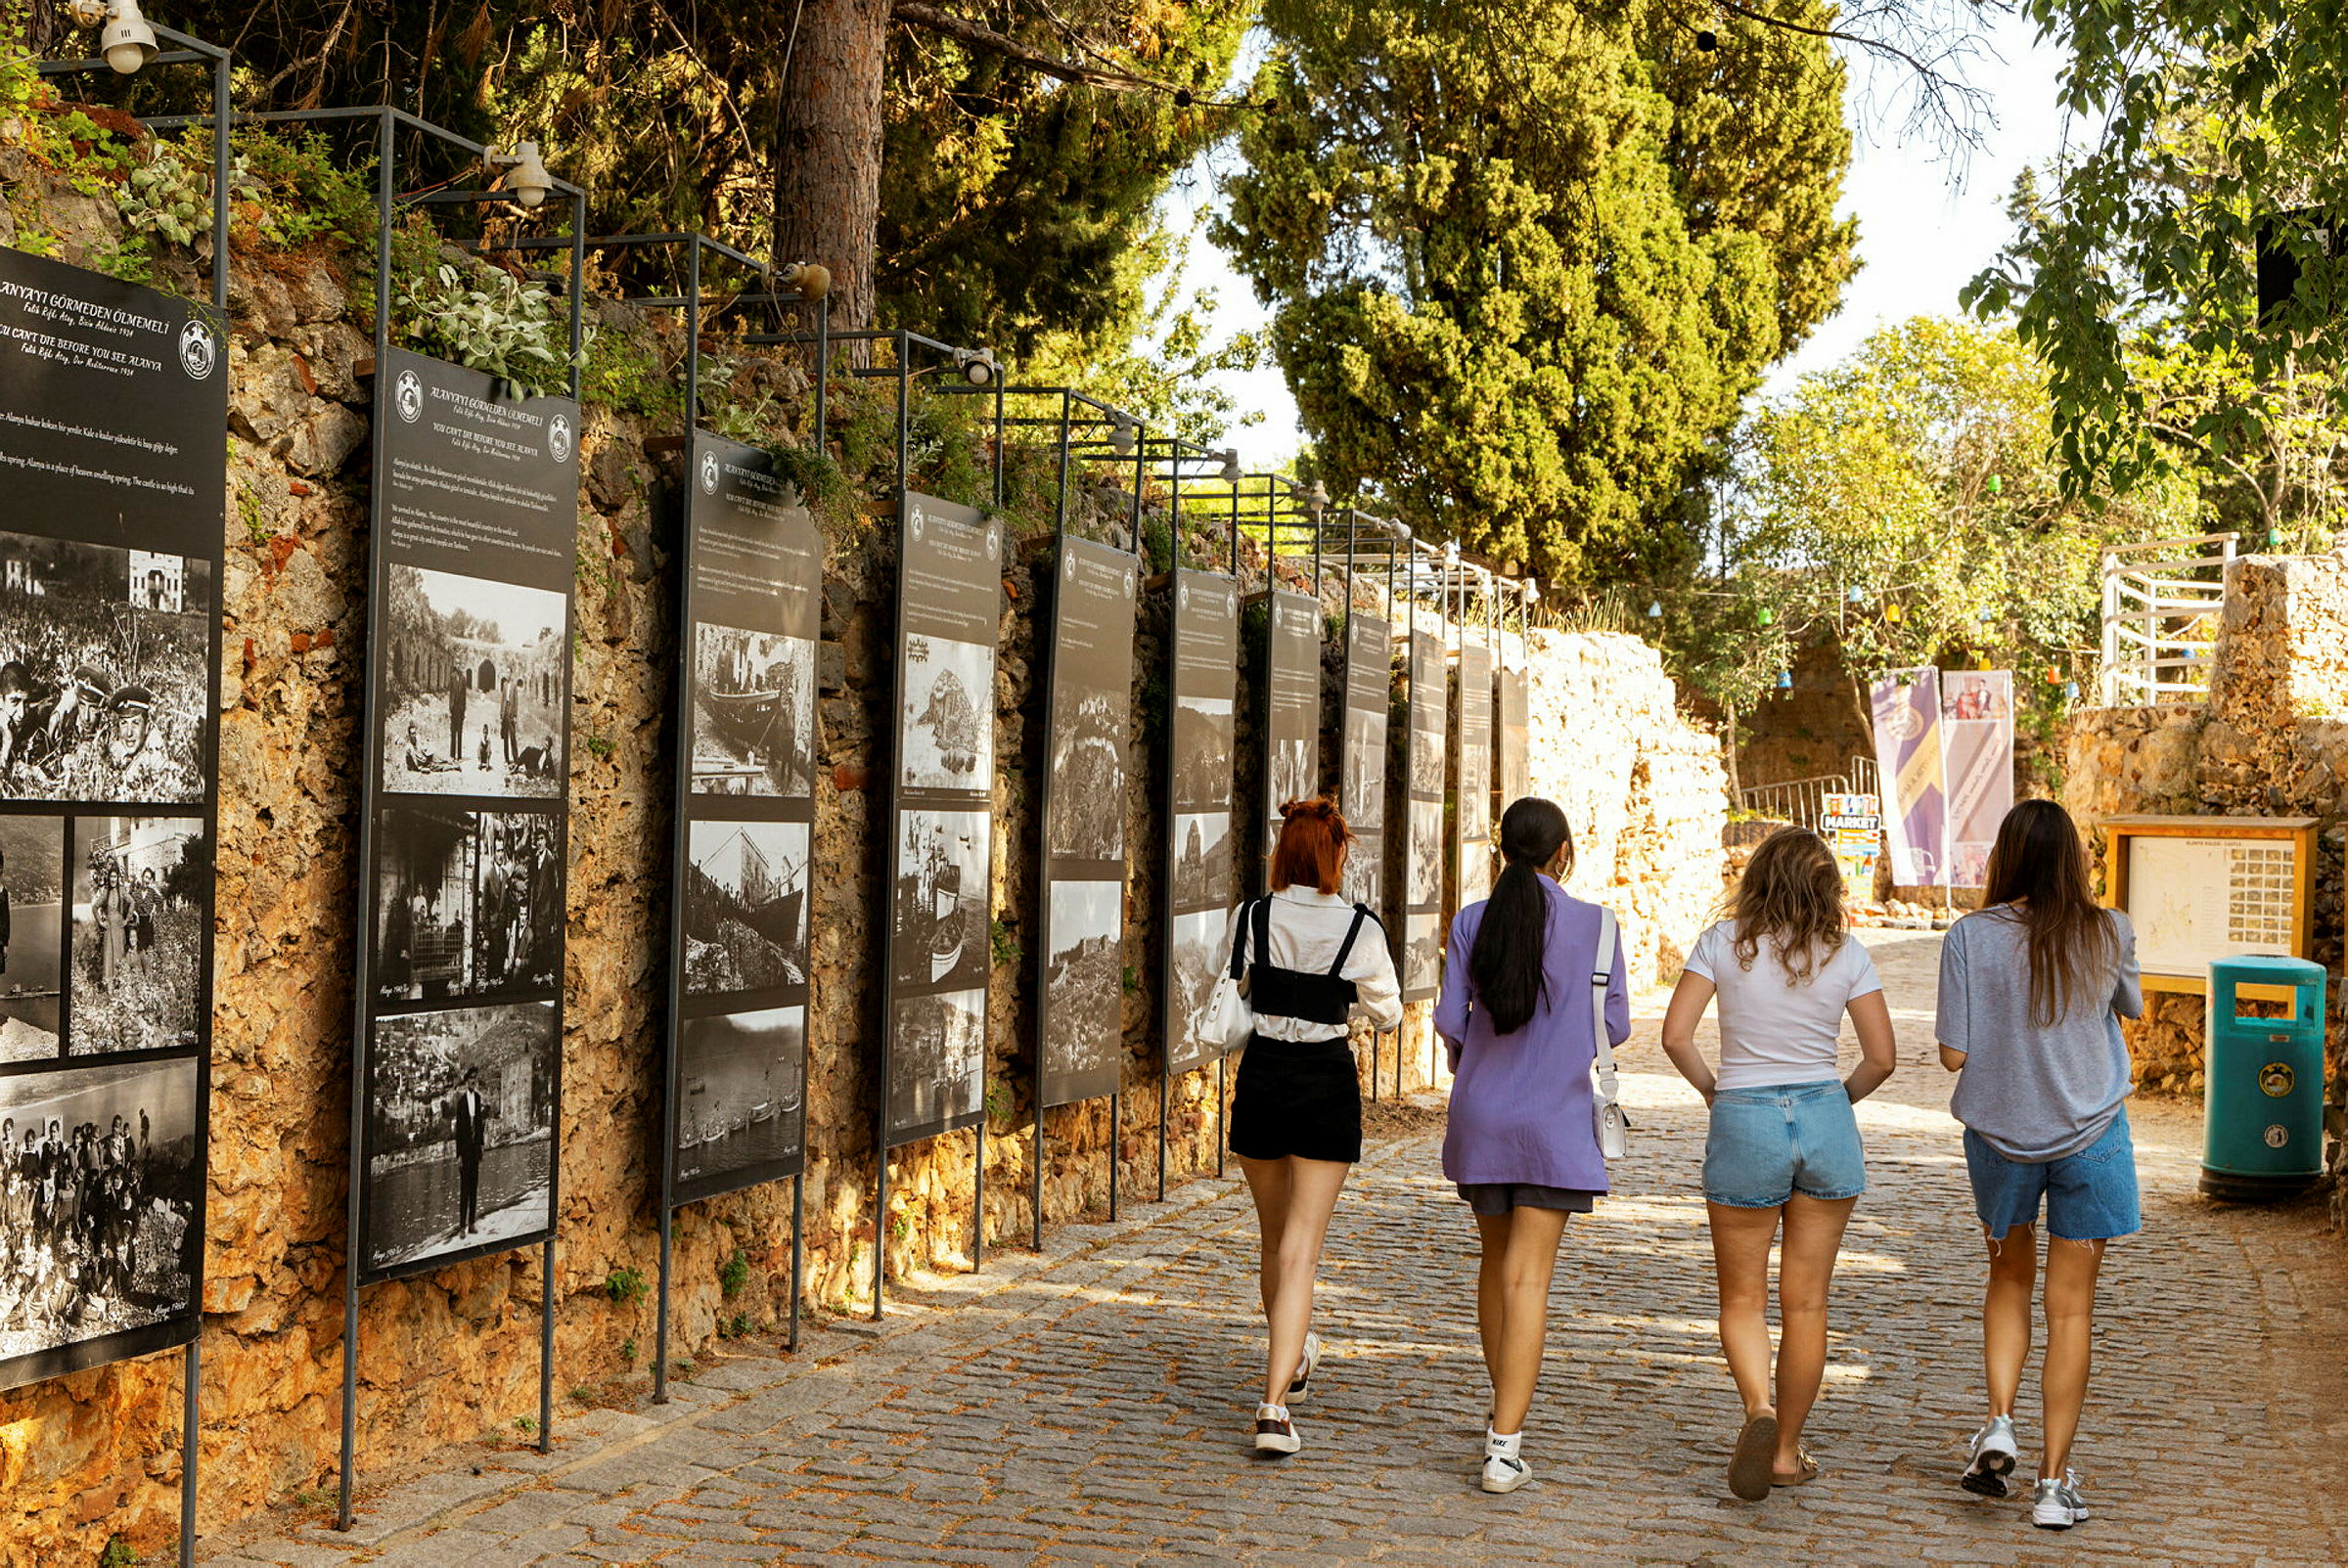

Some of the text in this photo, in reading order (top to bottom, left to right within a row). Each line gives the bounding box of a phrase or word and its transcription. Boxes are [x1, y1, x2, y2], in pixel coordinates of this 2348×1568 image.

[0, 281, 170, 336] ANYAYI GÖRMEDEN ÖLMEMELİ
[39, 334, 57, 347] DIE
[58, 338, 91, 355] BEFORE
[92, 346, 111, 360] YOU
[111, 351, 127, 364] SEE
[128, 355, 162, 372] ALANYA
[1825, 816, 1877, 829] MARKET
[1492, 1438, 1509, 1448] NIKE
